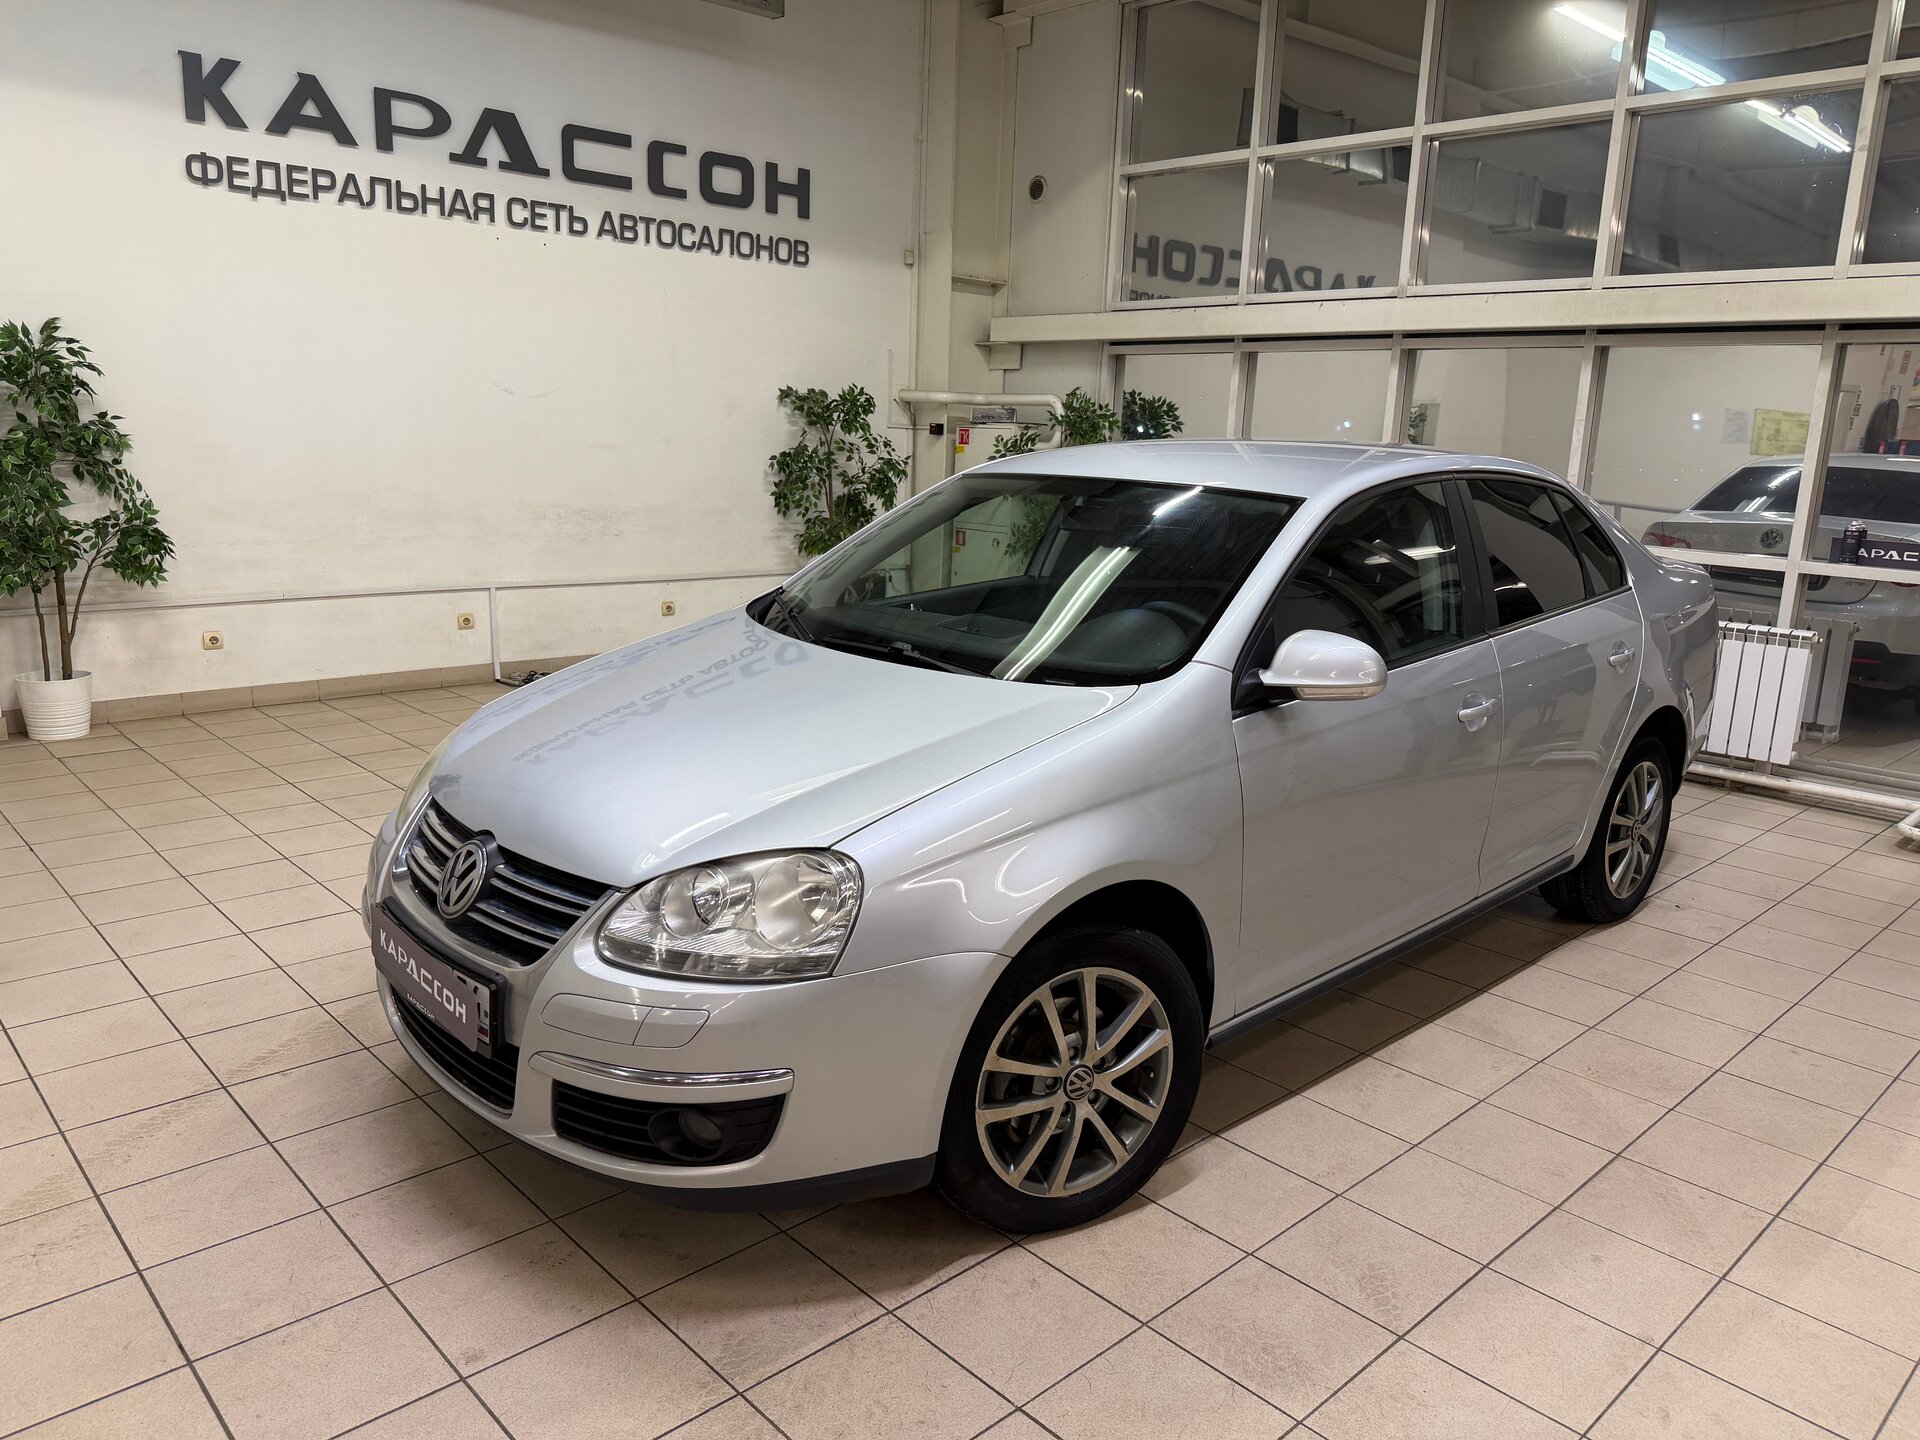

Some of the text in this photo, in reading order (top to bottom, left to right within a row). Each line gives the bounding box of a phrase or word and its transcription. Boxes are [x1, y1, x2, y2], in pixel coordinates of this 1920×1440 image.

[185, 151, 810, 266] ФЕДЕРАЛЬНАЯ СЕТЬ АВТОСАЛОНОВ
